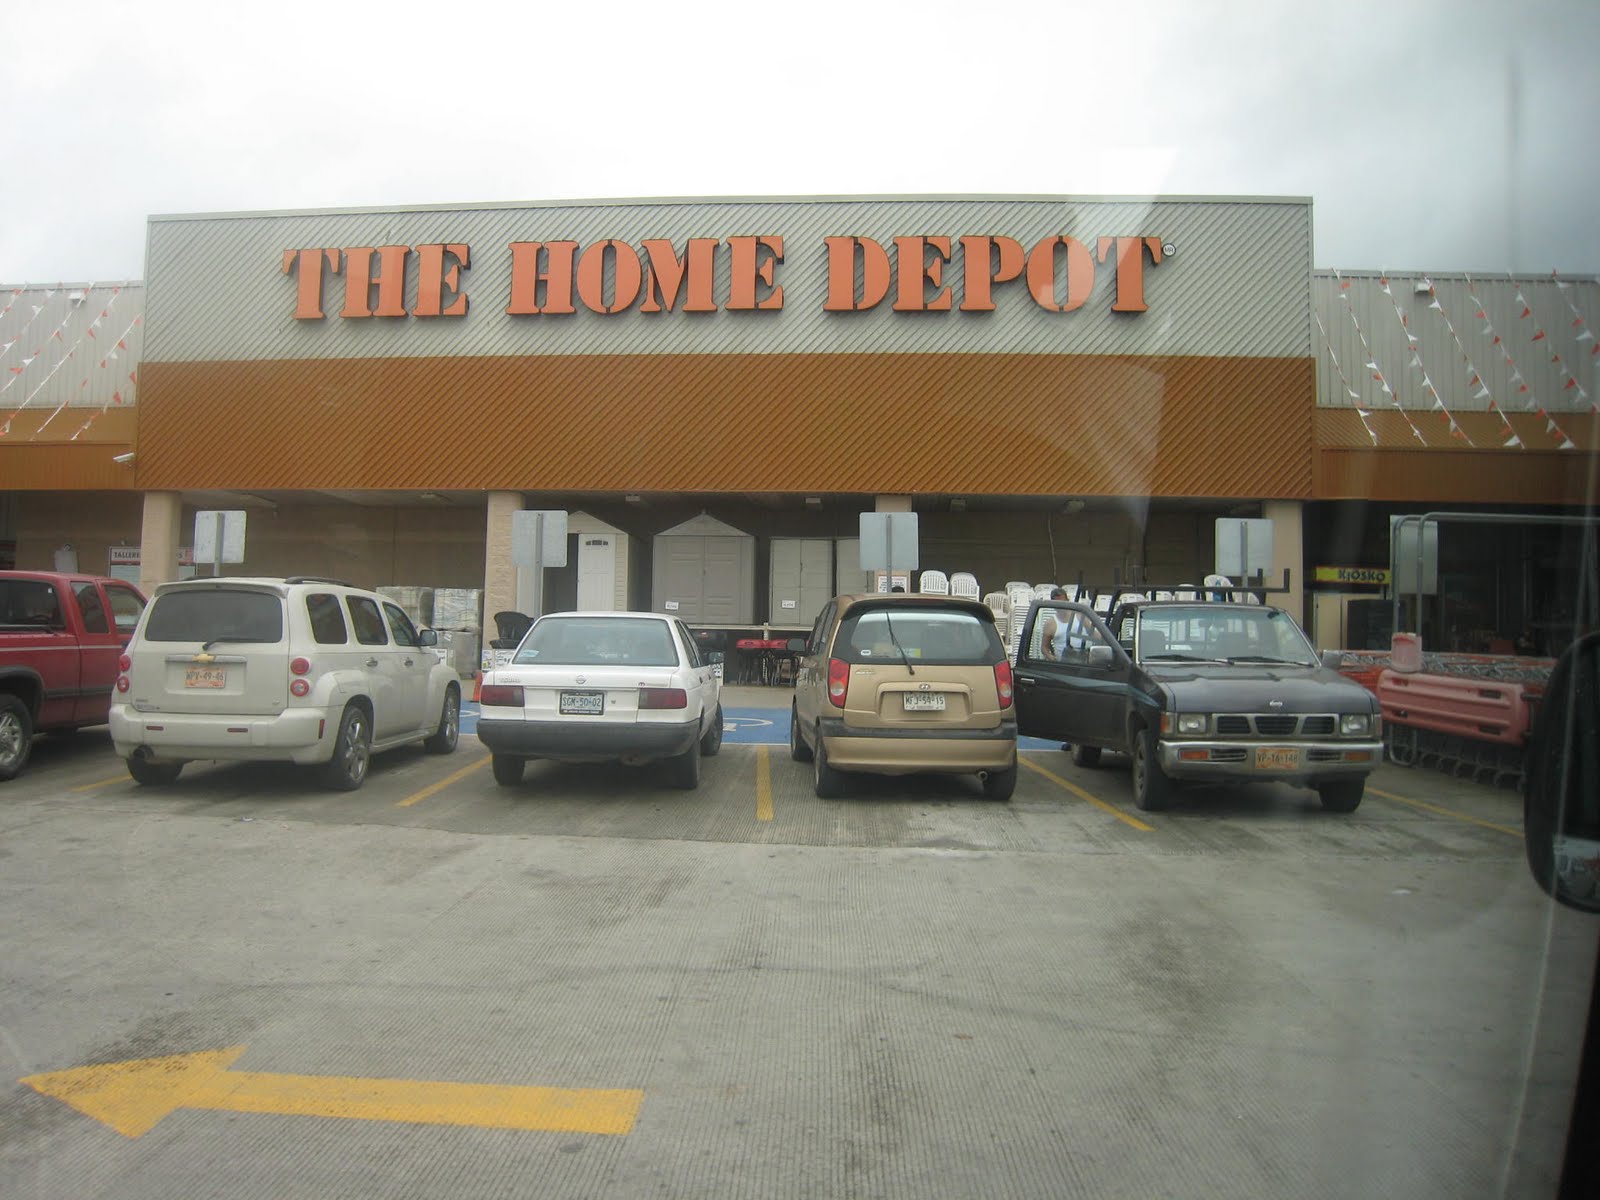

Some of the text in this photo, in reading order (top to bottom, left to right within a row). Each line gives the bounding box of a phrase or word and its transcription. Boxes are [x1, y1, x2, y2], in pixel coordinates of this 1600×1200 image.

[282, 243, 470, 319] THE
[505, 236, 785, 315] HOME
[823, 235, 1163, 313] DEPOT
[113, 551, 140, 559] TALLERE
[562, 696, 601, 707] SGM-50-02
